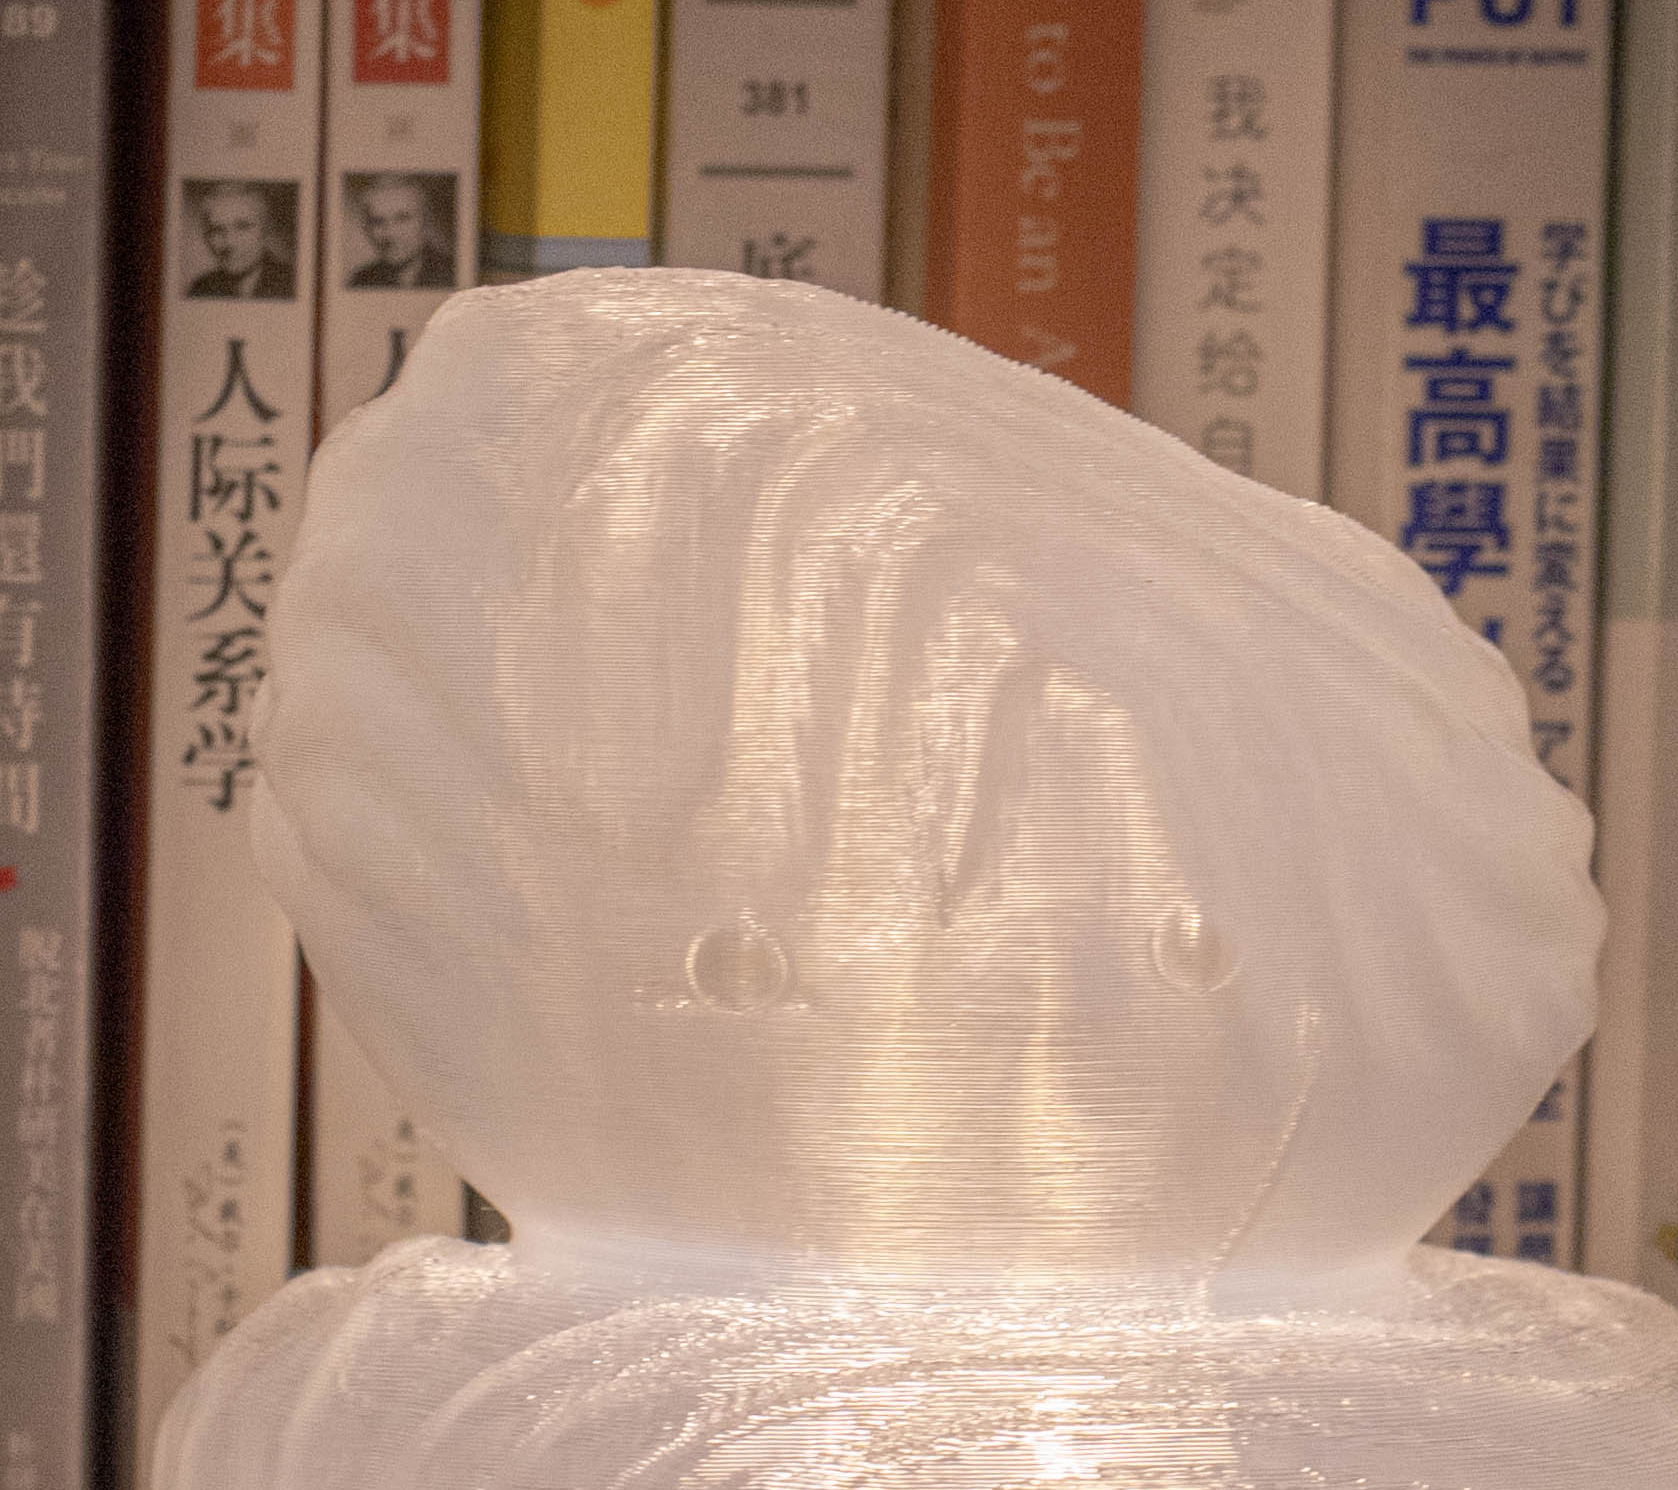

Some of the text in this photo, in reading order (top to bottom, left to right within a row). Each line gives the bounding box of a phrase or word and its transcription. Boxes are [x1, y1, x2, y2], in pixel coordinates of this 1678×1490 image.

[741, 81, 810, 116] 381
[1027, 24, 1074, 94] to
[1021, 118, 1081, 200] Be
[1015, 215, 1058, 293] an
[1401, 216, 1519, 646] 最高學
[180, 339, 282, 814] 人际关系学
